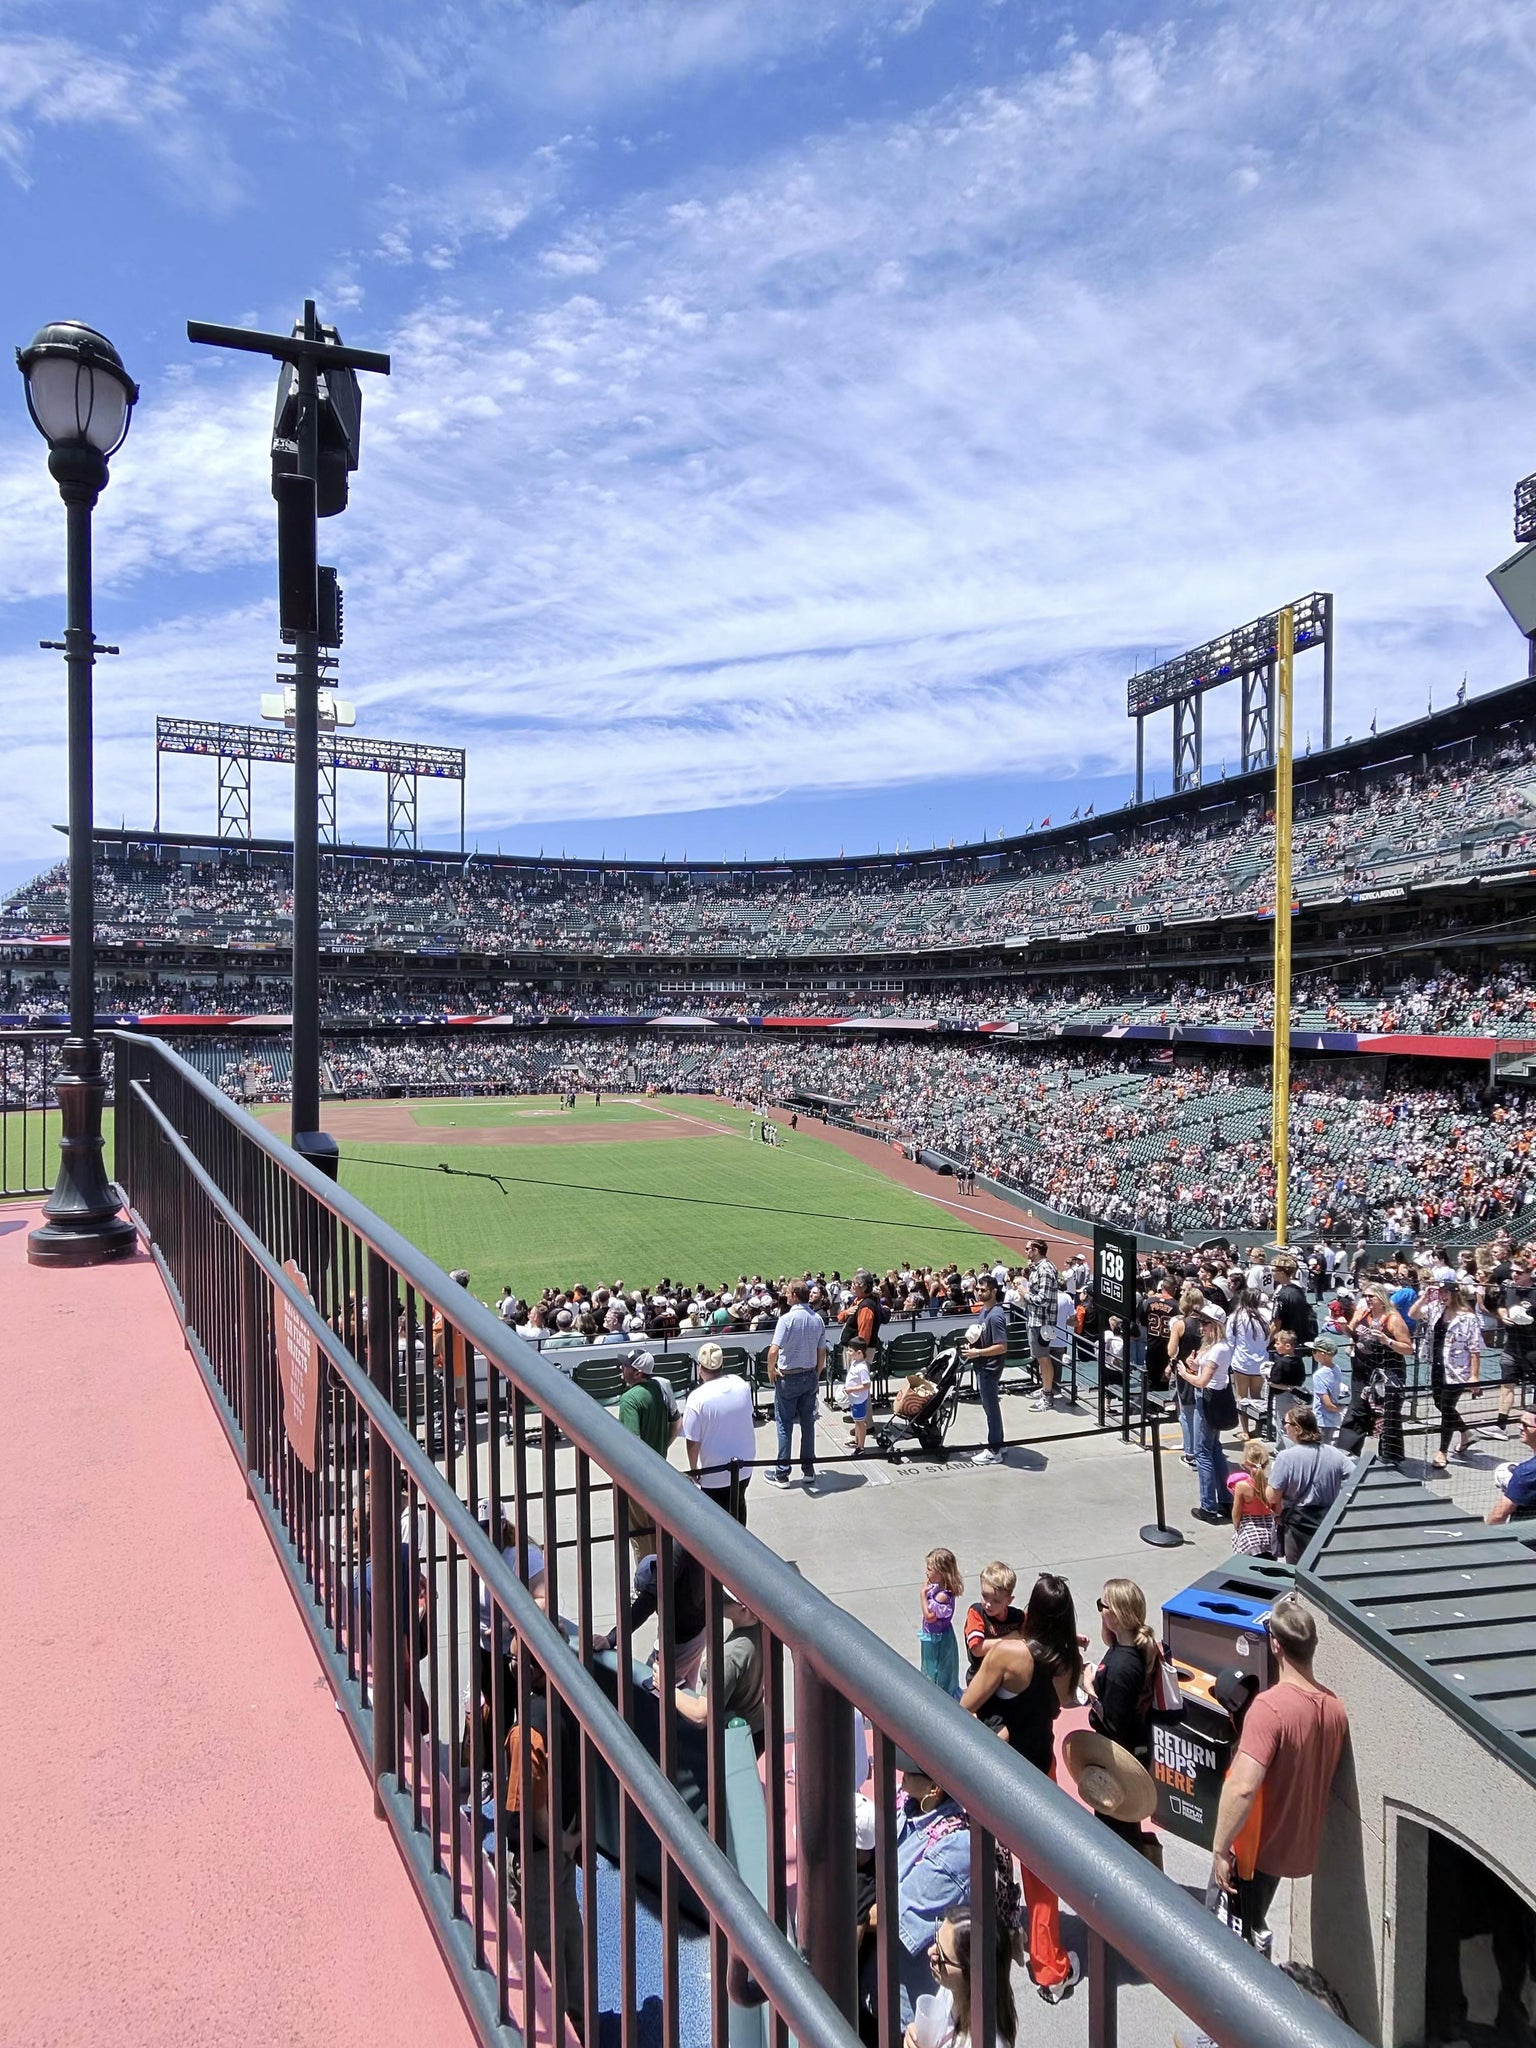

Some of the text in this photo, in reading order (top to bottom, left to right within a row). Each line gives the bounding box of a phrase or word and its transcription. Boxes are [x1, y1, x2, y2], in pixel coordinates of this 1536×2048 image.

[1100, 1249, 1124, 1282] 138
[287, 1337, 308, 1373] OBJECTS
[897, 1468, 920, 1477] NO
[1153, 1726, 1217, 1770] RETURN
[1154, 1745, 1197, 1779] CUPS
[1155, 1762, 1195, 1796] HERE
